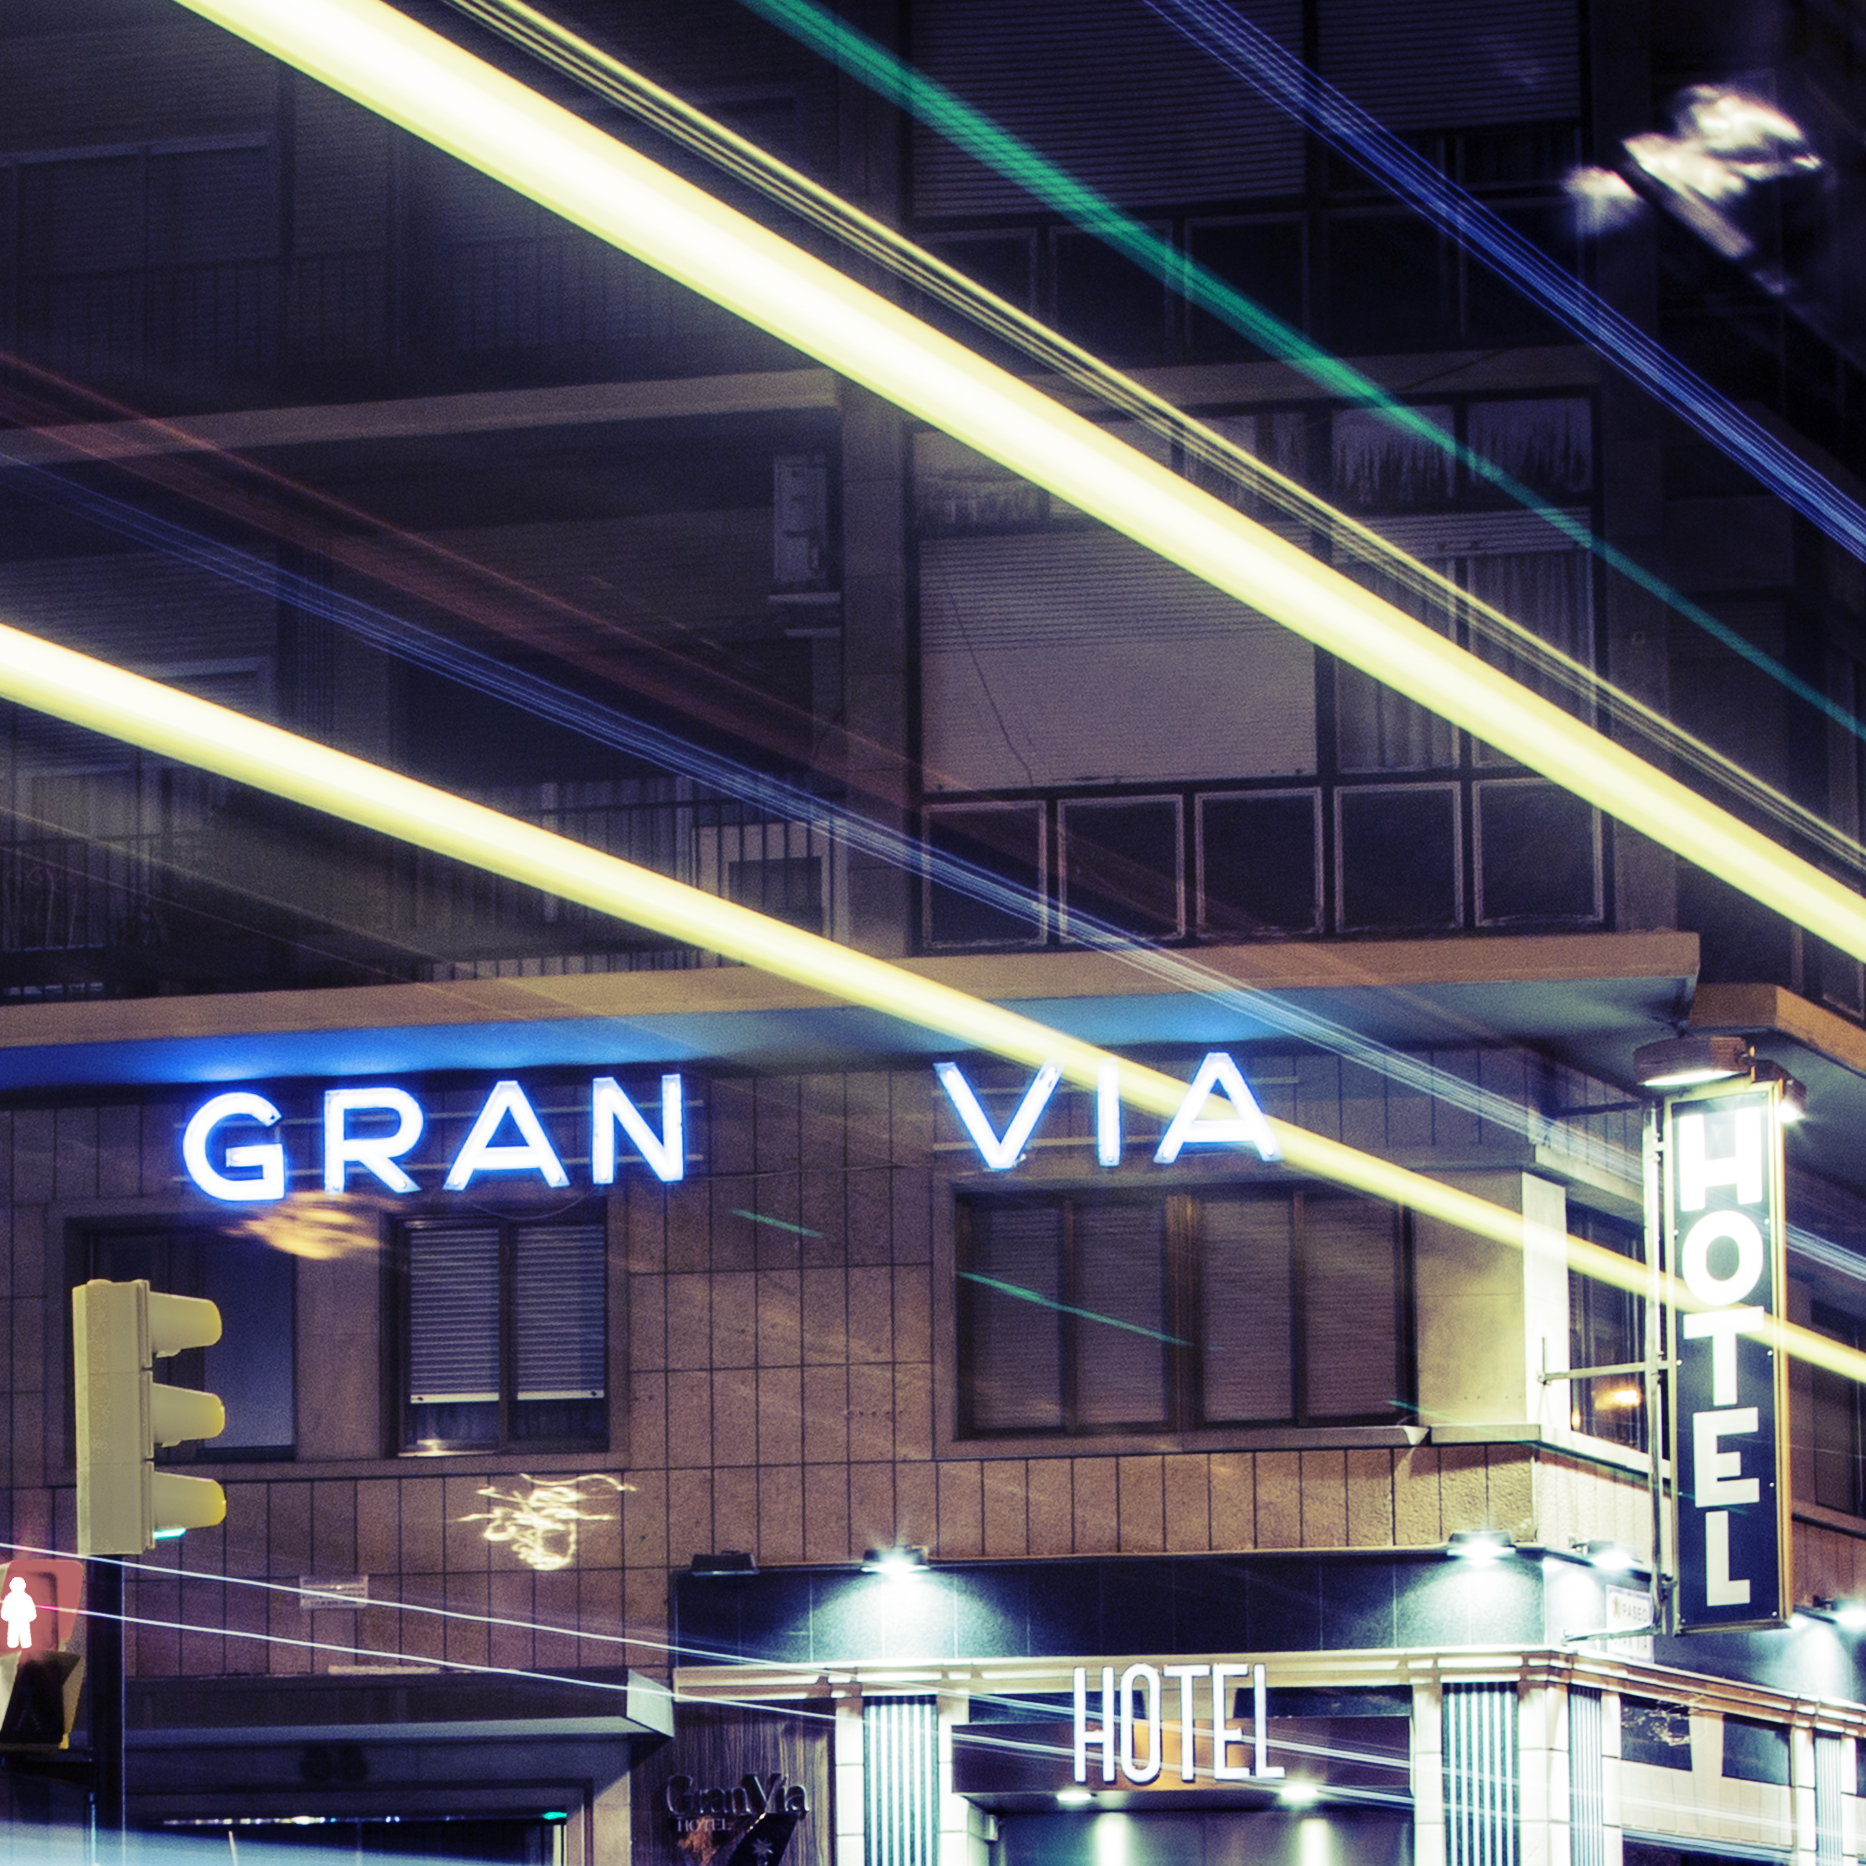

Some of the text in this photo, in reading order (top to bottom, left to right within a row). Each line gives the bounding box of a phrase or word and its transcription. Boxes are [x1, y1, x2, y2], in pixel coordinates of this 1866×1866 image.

[182, 1074, 684, 1201] GRAN
[933, 1052, 1283, 1170] VIA
[1678, 1106, 1765, 1607] HOTEL
[1073, 1663, 1285, 1783] HOTEL
[677, 1817, 732, 1833] HOTEL
